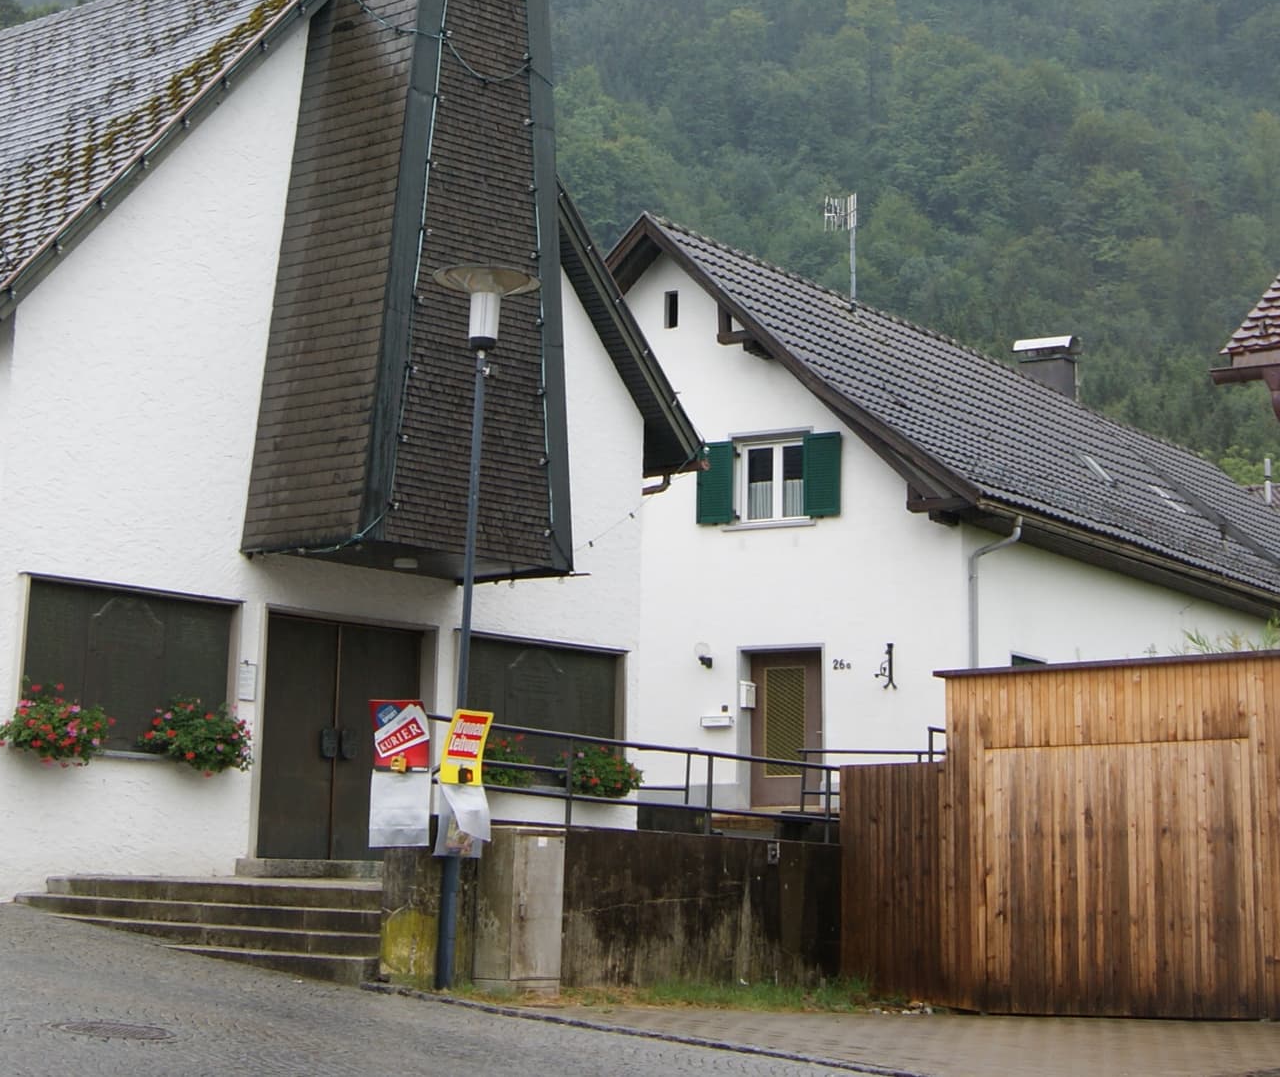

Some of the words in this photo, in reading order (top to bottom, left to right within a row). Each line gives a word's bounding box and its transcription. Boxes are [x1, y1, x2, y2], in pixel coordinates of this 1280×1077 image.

[832, 658, 852, 671] 26a
[379, 723, 422, 752] KURIER
[453, 718, 486, 737] Kronen
[448, 734, 481, 755] Zeitung
